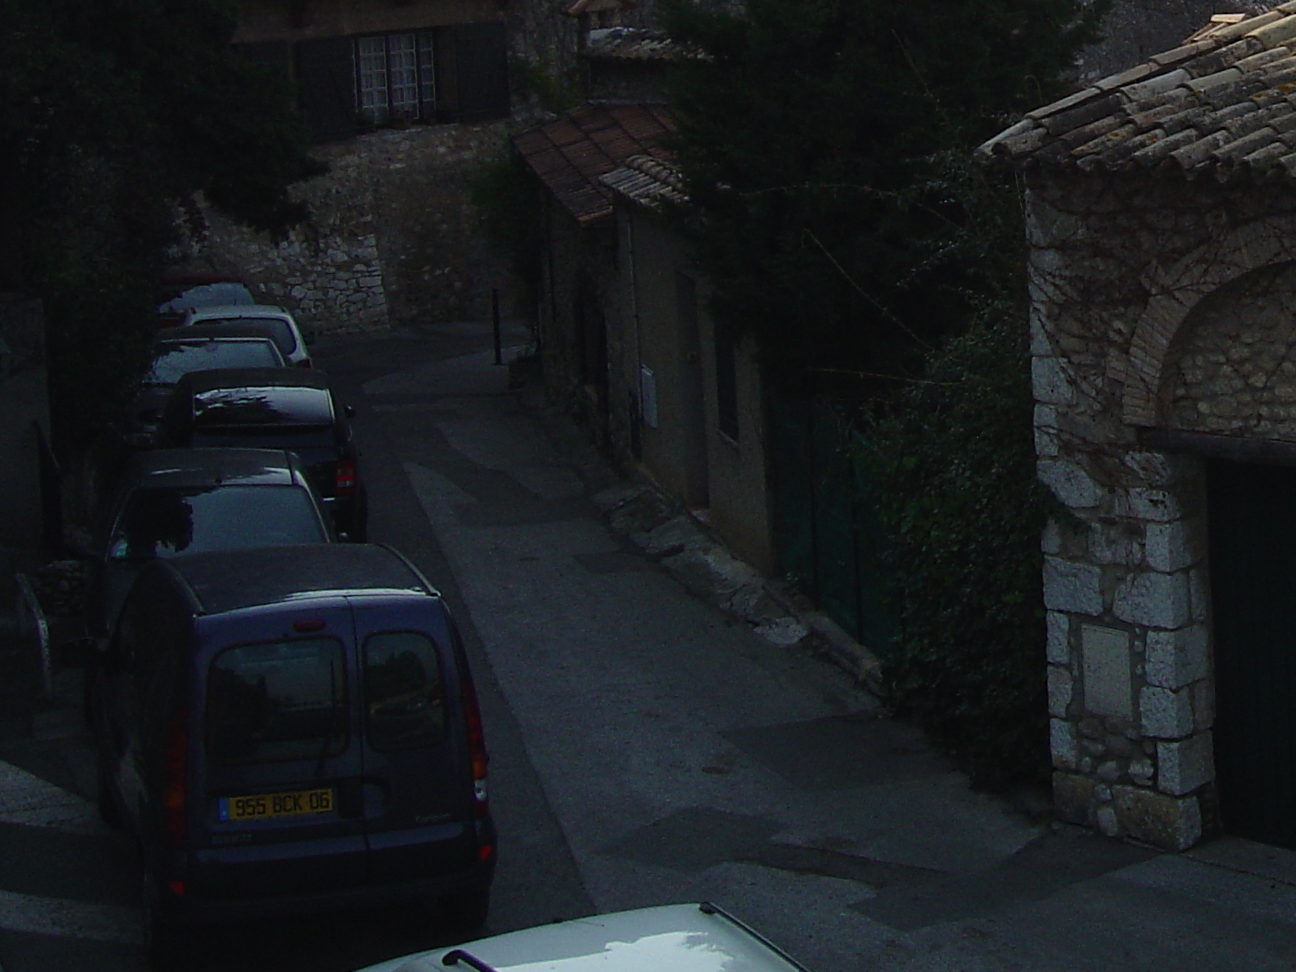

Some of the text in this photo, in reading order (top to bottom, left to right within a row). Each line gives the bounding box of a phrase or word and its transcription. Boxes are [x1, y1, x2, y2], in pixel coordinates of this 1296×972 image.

[234, 792, 330, 816] 955 BCK 06
